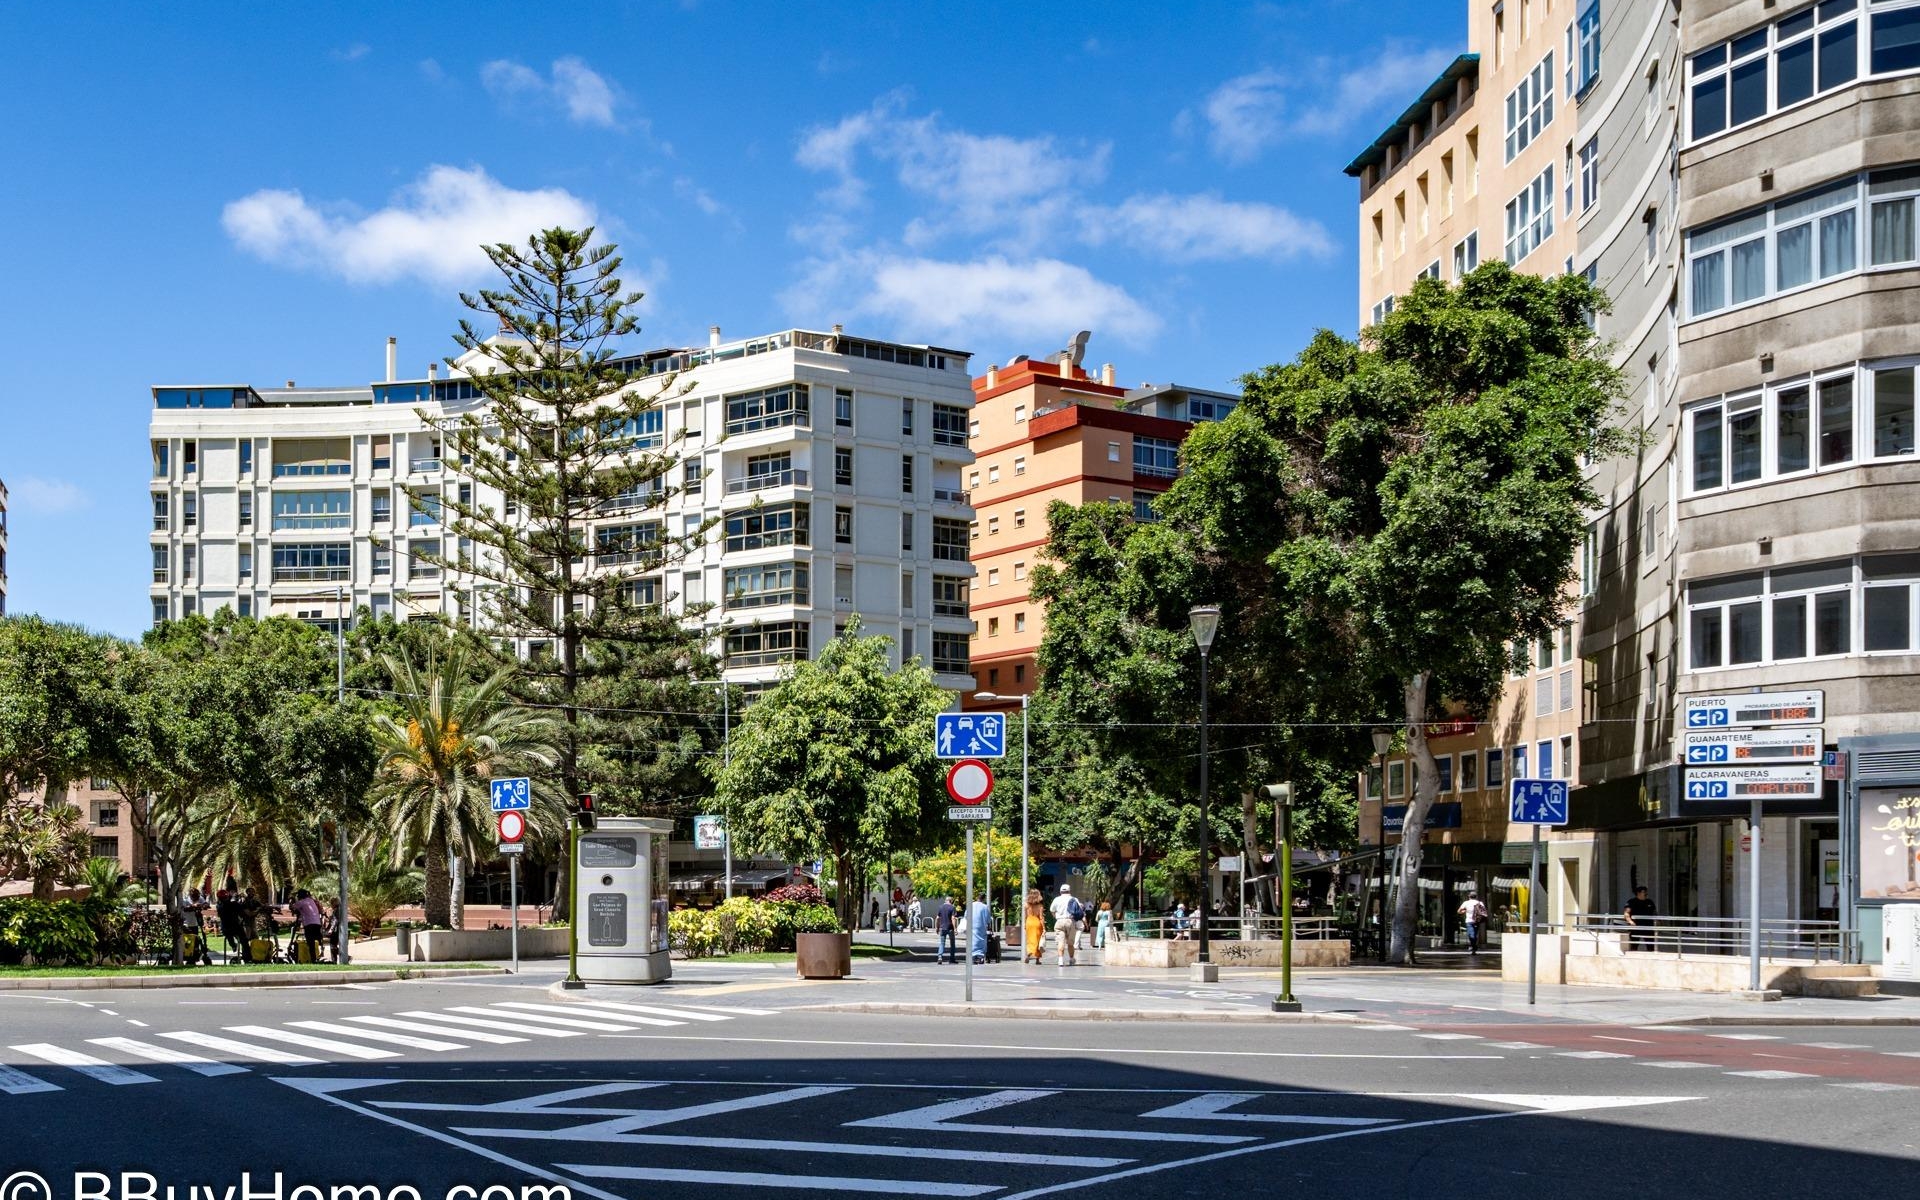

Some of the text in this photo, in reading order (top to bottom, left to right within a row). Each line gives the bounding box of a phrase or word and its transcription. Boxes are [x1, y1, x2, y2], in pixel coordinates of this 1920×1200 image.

[1689, 699, 1726, 707] PUERTO
[1771, 708, 1808, 719] LIBRE
[1689, 734, 1753, 743] GUANARTEME
[1689, 771, 1769, 779] ALCARAVANERAS
[1747, 783, 1808, 794] COMPLETO
